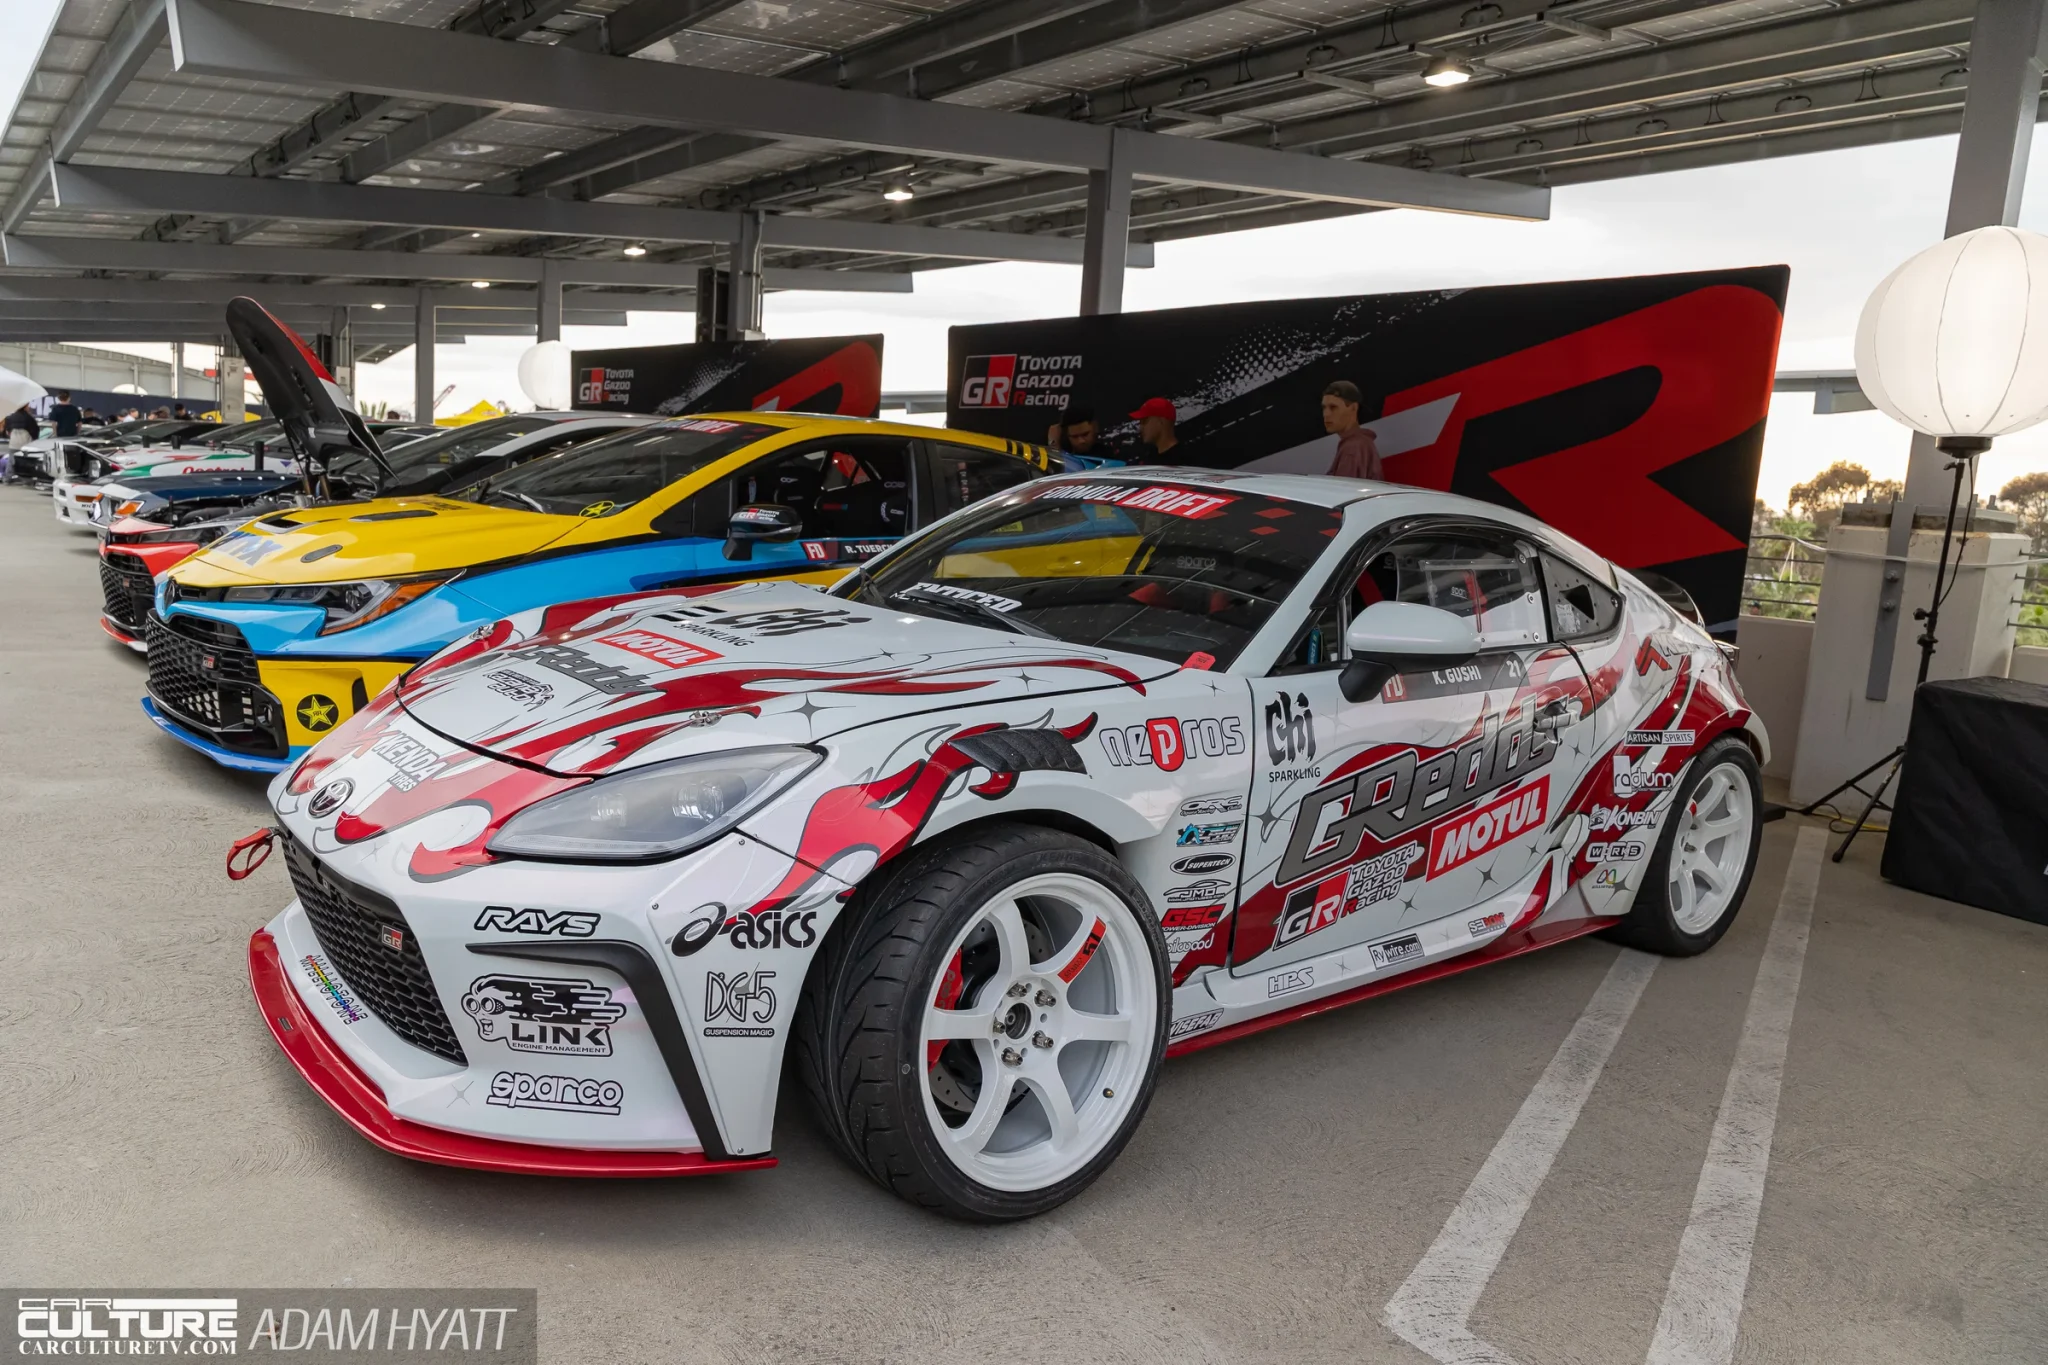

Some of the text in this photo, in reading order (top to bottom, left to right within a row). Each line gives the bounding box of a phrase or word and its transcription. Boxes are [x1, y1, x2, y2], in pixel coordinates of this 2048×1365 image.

[605, 368, 634, 379] TOYOTA
[1018, 355, 1082, 371] TOYOTA
[579, 382, 602, 402] GR
[603, 380, 631, 391] GAZOO
[962, 376, 1011, 405] GR
[1014, 374, 1075, 389] GAZOO
[1012, 390, 1070, 411] Racing
[1032, 486, 1226, 516] FORMULA DRIFT
[805, 543, 826, 559] FD
[1177, 555, 1216, 571] sparco
[673, 623, 754, 647] SPARKLING
[604, 632, 706, 665] MOTUL
[1432, 665, 1483, 685] K. GUSHI
[1507, 659, 1522, 678] 21
[1099, 715, 1246, 773] nepros
[1626, 732, 1693, 743] ARTISAN SPIRITS
[371, 733, 449, 782] KENDA
[387, 771, 418, 793] TIRES
[1268, 767, 1321, 783] SPARKLING
[1614, 767, 1675, 790] radium
[1180, 796, 1243, 812] ORC
[1434, 786, 1541, 872] MOTUL
[1187, 858, 1231, 869] SUPERTECH
[1353, 845, 1416, 881] TOYOTA
[1348, 864, 1407, 900] GAZOO
[1341, 884, 1401, 918] Racing
[475, 906, 601, 938] RAYS
[1162, 904, 1225, 927] GSC
[1279, 893, 1341, 943] GR
[383, 933, 401, 948] GR
[730, 910, 817, 950] asics
[1268, 967, 1314, 998] HPS
[511, 1023, 606, 1046] LINK
[705, 1028, 749, 1036] SUSPENSION
[511, 1042, 606, 1053] ENGINE MANAGEMENT
[488, 1071, 624, 1115] sparco
